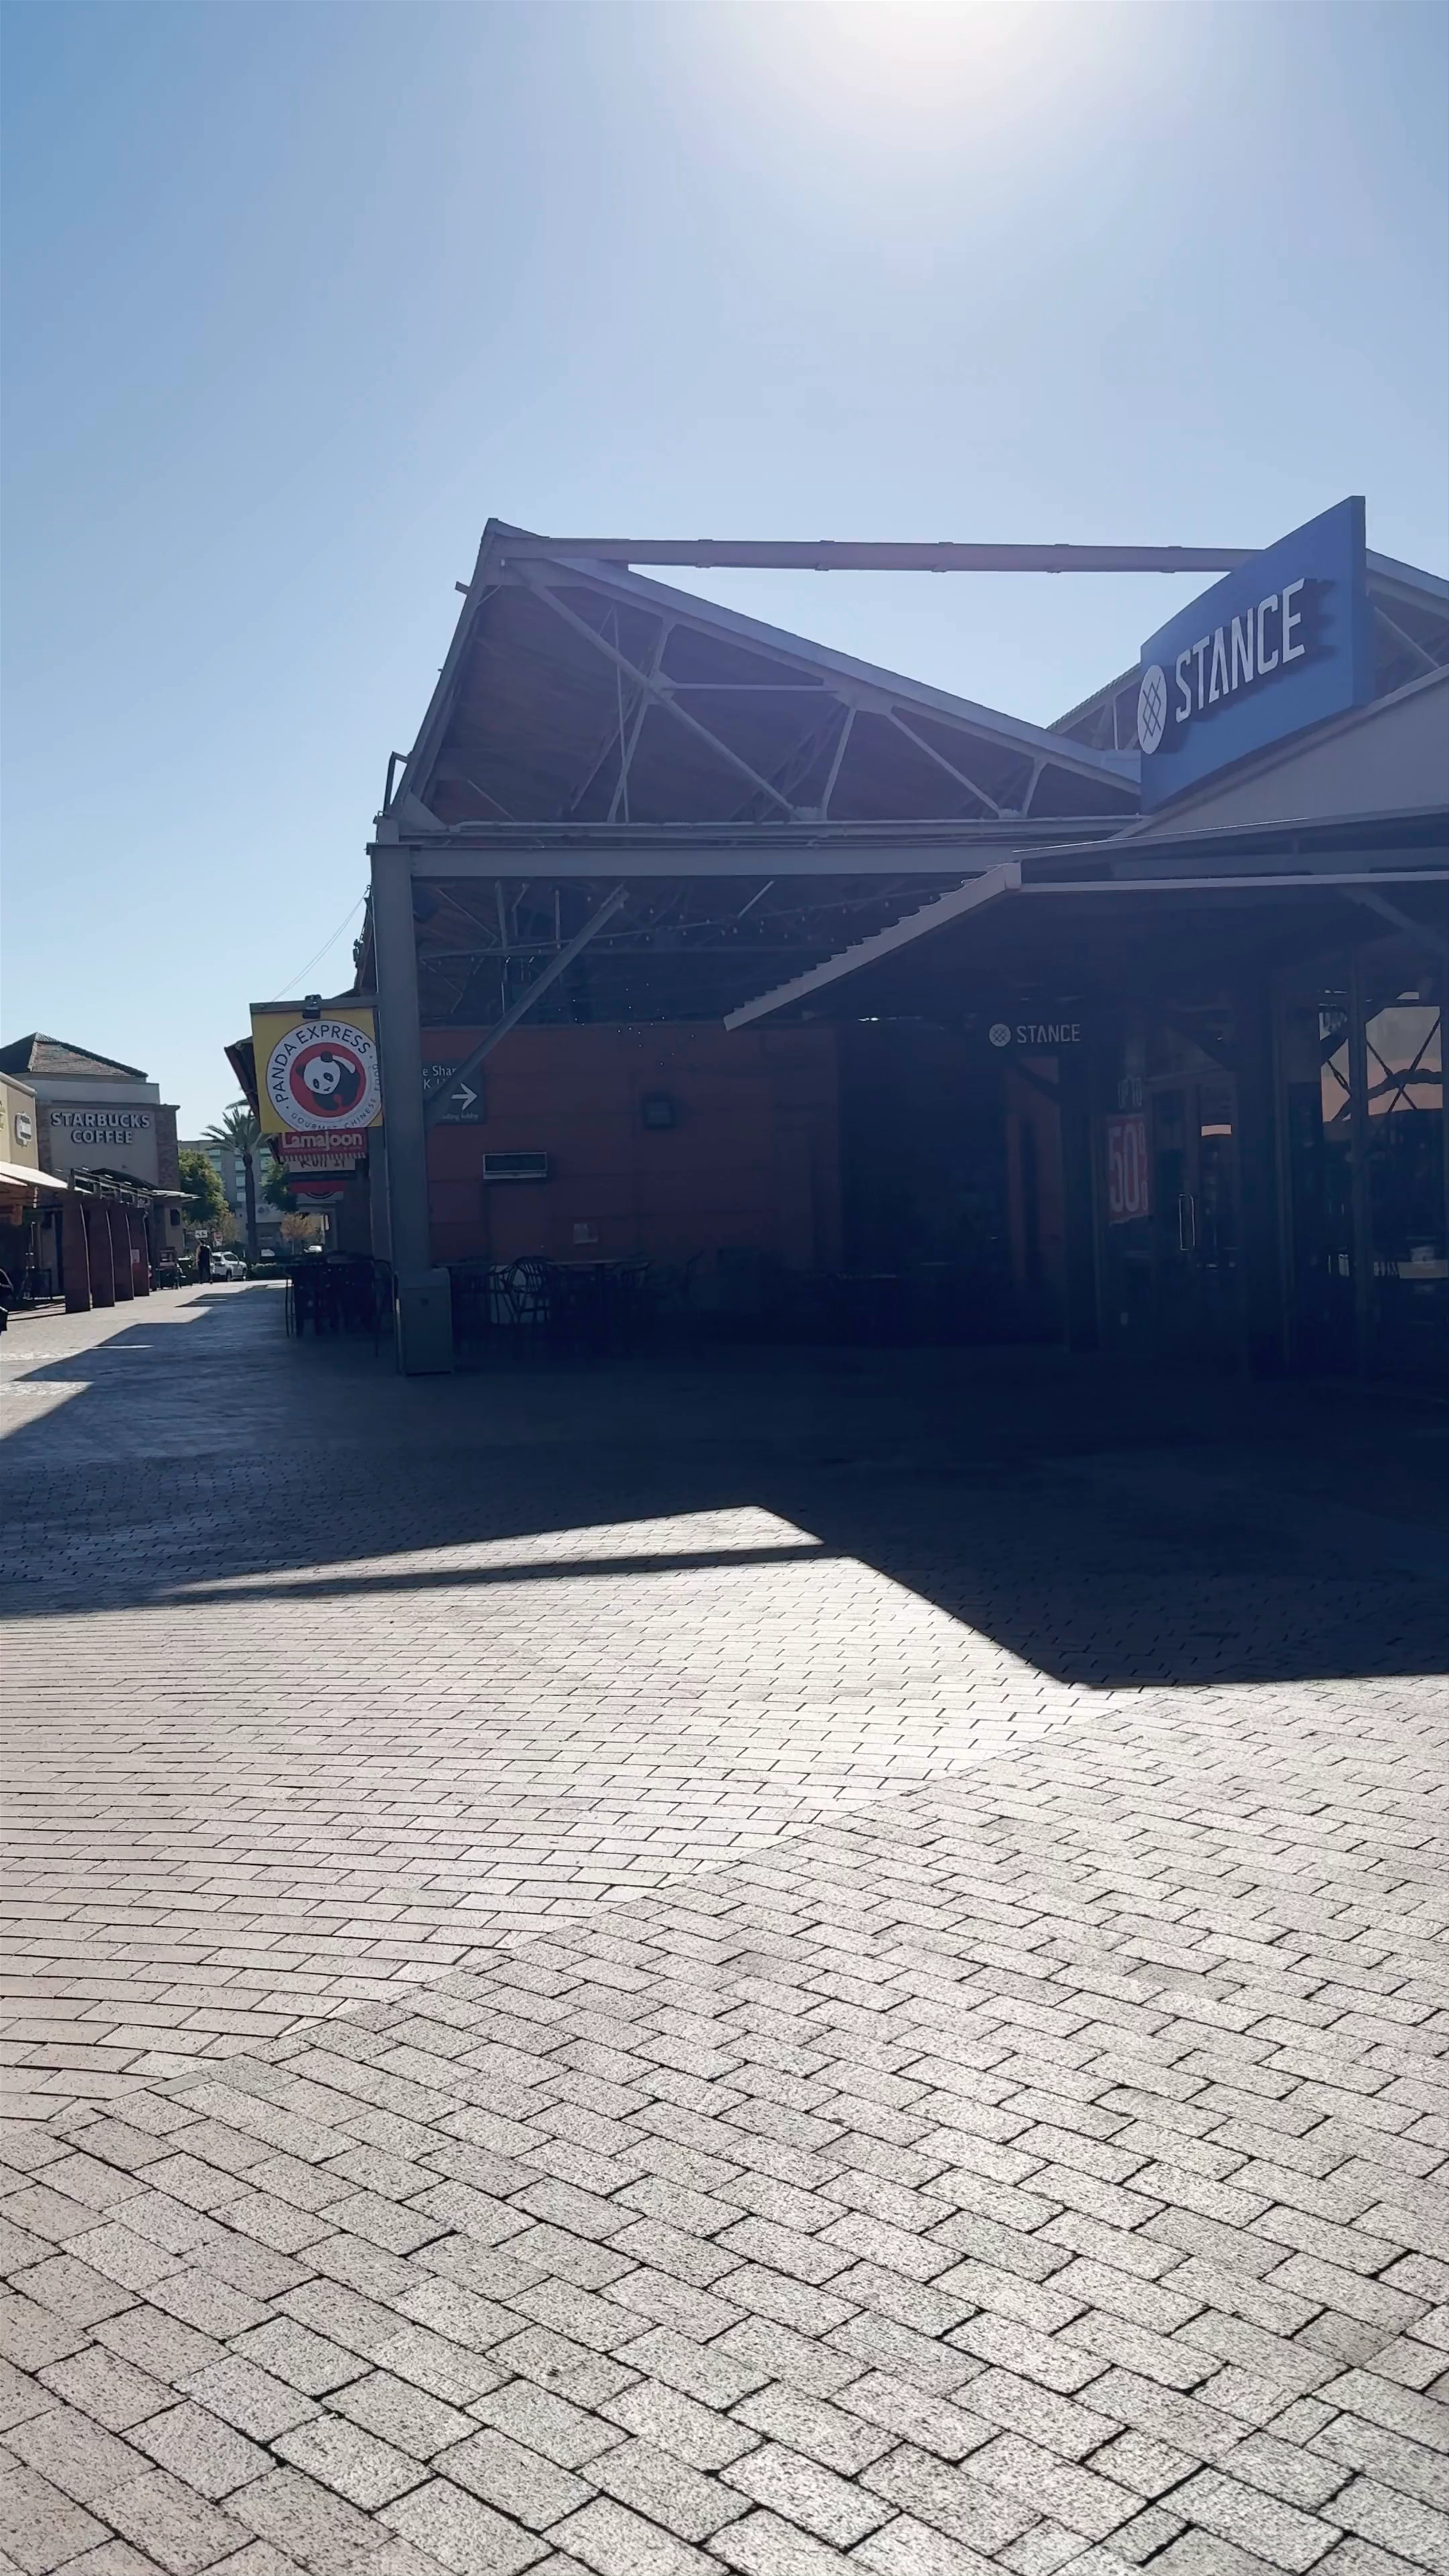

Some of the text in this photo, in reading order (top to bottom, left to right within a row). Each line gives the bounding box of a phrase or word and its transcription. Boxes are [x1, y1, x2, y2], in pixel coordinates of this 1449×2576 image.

[1175, 578, 1306, 723] STANCE
[1017, 1024, 1081, 1043] STANCE
[272, 1024, 371, 1103] PANDA EXPRESS
[51, 1112, 150, 1128] STARBUCKS
[71, 1130, 134, 1144] COFFEE
[282, 1131, 362, 1151] Lamajoon
